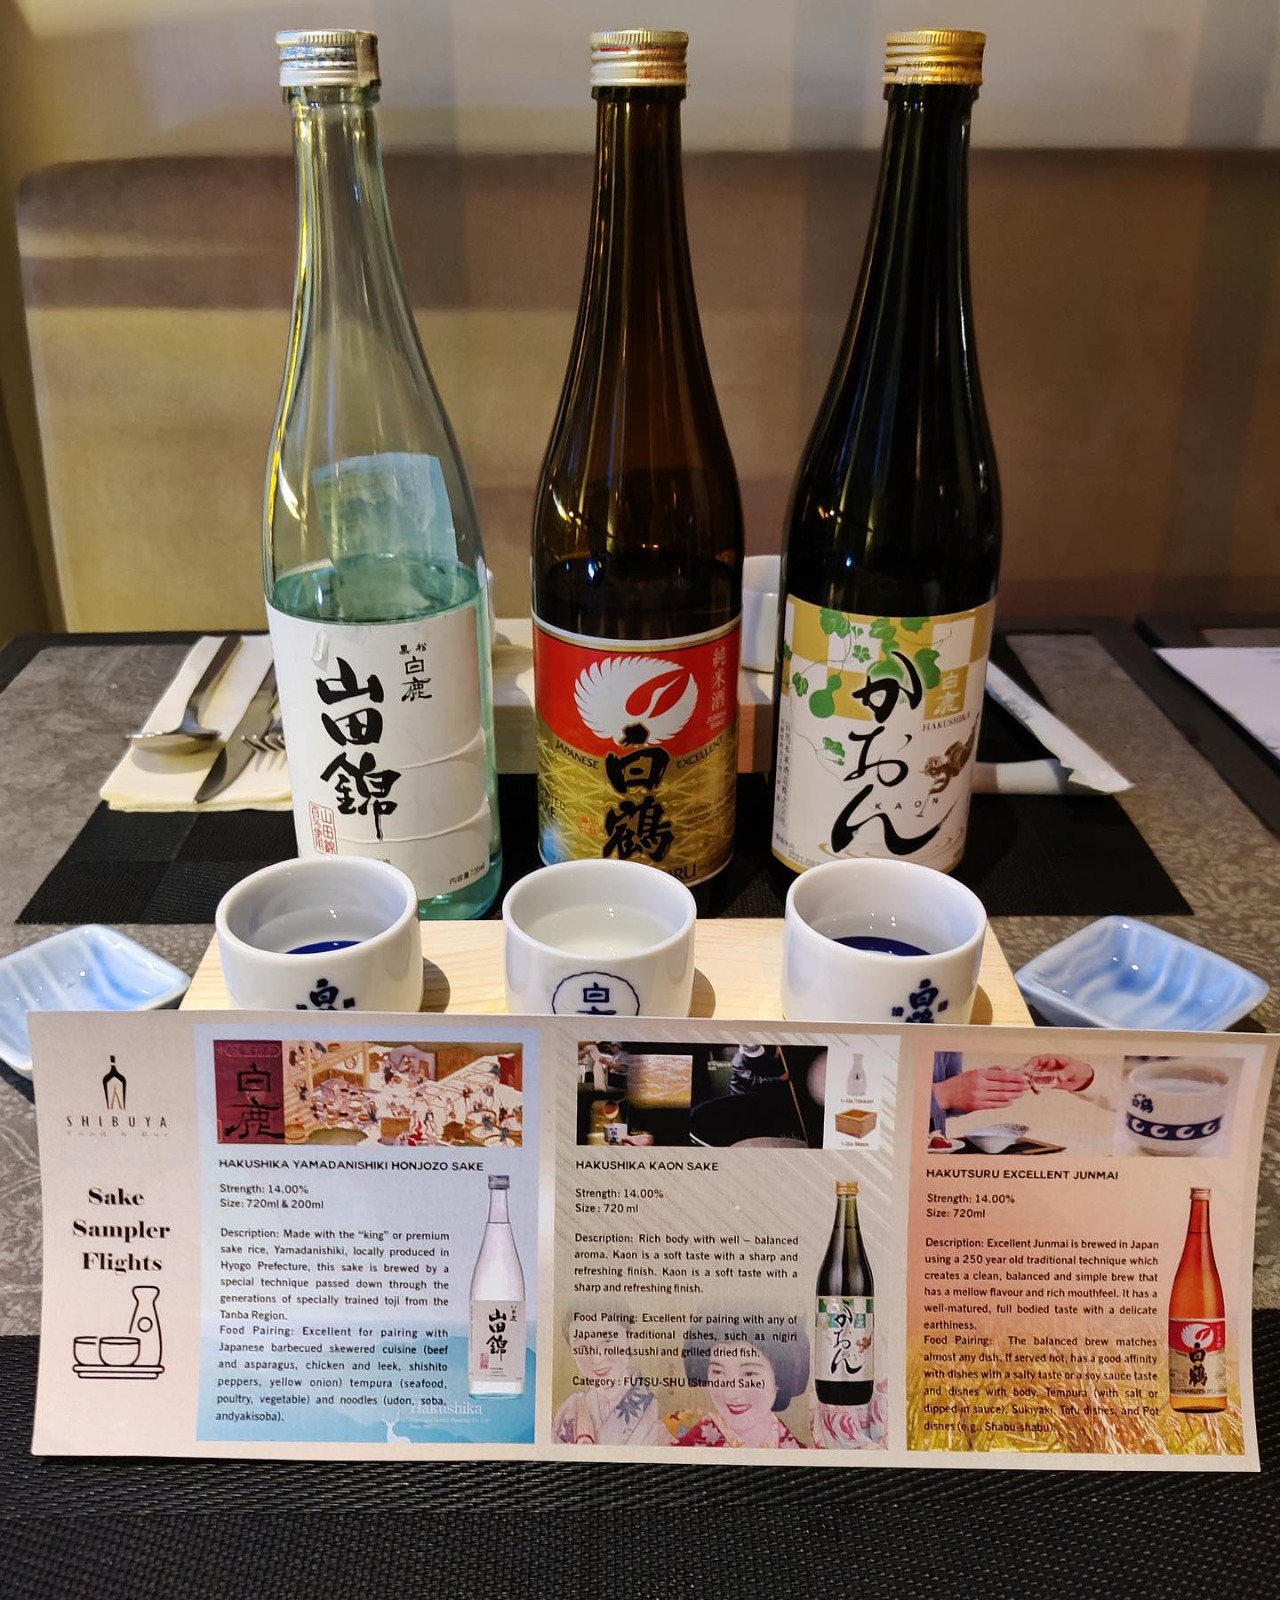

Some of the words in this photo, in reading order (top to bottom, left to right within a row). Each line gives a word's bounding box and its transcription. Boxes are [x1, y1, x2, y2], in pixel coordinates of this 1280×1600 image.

[402, 656, 432, 702] 白鹿
[316, 657, 402, 840] 山田錦
[555, 741, 599, 769] JAPANESE
[676, 737, 725, 769] EXCELLENT
[831, 651, 956, 855] かおん
[874, 796, 939, 811] KAON
[224, 1061, 285, 1140] 白鹿
[66, 1115, 167, 1128] SHIBUYA
[219, 1159, 289, 1169] HAKUSHIKA
[293, 1160, 388, 1170] YAMADANISHIKI
[391, 1161, 448, 1170] HONJOZO
[451, 1162, 483, 1171] SAKE
[576, 1160, 646, 1170] HAKUSHIKA
[649, 1161, 683, 1170] KAON
[686, 1161, 718, 1171] SAKE
[926, 1169, 999, 1178] HAKUTSURU
[1003, 1169, 1070, 1179] EXCELLENT
[1072, 1170, 1118, 1180] JUNMAI
[219, 1183, 265, 1195] Strength:
[268, 1184, 308, 1194] 14.00%
[575, 1188, 620, 1200] Strength:
[624, 1188, 664, 1198] 14.00%
[88, 1186, 144, 1206] Sake
[927, 1193, 971, 1205] Strength:
[976, 1194, 1015, 1203] 14.00%
[220, 1198, 243, 1207] Size:
[246, 1198, 279, 1208] 720ml
[291, 1199, 324, 1209] 200ml
[603, 1203, 624, 1213] 720
[626, 1204, 638, 1213] ml
[926, 1208, 949, 1218] Size:
[953, 1208, 985, 1218] 720ml
[72, 1219, 170, 1243] Sampler
[220, 1227, 279, 1239] Description:
[283, 1228, 310, 1238] Made
[314, 1230, 335, 1239] with
[338, 1230, 354, 1239] the
[405, 1231, 449, 1242] premium
[574, 1232, 633, 1244] Description:
[638, 1233, 660, 1243] Rich
[665, 1234, 689, 1245] body
[693, 1234, 715, 1244] with
[720, 1234, 739, 1244] well
[754, 1235, 798, 1245] balanced
[925, 1237, 984, 1249] Description:
[987, 1238, 1030, 1248] Excellent
[1033, 1239, 1068, 1248] Junmai
[1081, 1239, 1116, 1249] brewed
[1130, 1240, 1159, 1251] Japan
[220, 1244, 242, 1253] sake
[247, 1244, 269, 1255] rice,
[274, 1245, 347, 1256] Yamadanishiki,
[353, 1246, 384, 1258] locally
[389, 1247, 435, 1258] produced
[574, 1251, 608, 1259] aroma.
[612, 1249, 637, 1259] Kaon
[664, 1250, 681, 1260] soft
[685, 1251, 710, 1260] taste
[714, 1251, 735, 1261] with
[749, 1252, 776, 1263] sharp
[780, 1252, 798, 1261] and
[81, 1251, 163, 1275] Flights
[220, 1260, 251, 1272] Hyogo
[257, 1260, 310, 1272] Prefecture,
[317, 1262, 335, 1271] this
[341, 1262, 363, 1272] sake
[383, 1263, 419, 1272] brewed
[924, 1254, 951, 1265] using
[962, 1254, 983, 1264] 250
[985, 1257, 1006, 1266] year
[1008, 1255, 1024, 1264] old
[1026, 1255, 1076, 1264] traditional
[1078, 1255, 1126, 1267] technique
[1129, 1256, 1158, 1265] which
[574, 1266, 622, 1277] refreshing
[627, 1266, 656, 1276] finish.
[662, 1267, 686, 1276] Kaon
[715, 1267, 733, 1277] soft
[738, 1268, 761, 1277] taste
[766, 1268, 787, 1278] with
[924, 1271, 960, 1280] creates
[972, 1271, 1002, 1281] clean,
[1006, 1271, 1050, 1280] balanced
[1053, 1271, 1072, 1281] and
[1076, 1272, 1107, 1283] simple
[1111, 1272, 1134, 1282] brew
[1138, 1272, 1158, 1282] that
[220, 1276, 254, 1288] special
[260, 1277, 309, 1289] technique
[315, 1278, 349, 1290] passed
[355, 1279, 382, 1288] down
[389, 1279, 427, 1291] through
[433, 1280, 449, 1290] the
[924, 1286, 941, 1296] has
[952, 1287, 987, 1296] mellow
[990, 1287, 1023, 1297] flavour
[1025, 1288, 1044, 1297] and
[1046, 1288, 1065, 1297] rich
[1067, 1288, 1119, 1298] mouthfeel.
[1132, 1288, 1149, 1298] has
[220, 1293, 276, 1305] generations
[296, 1294, 339, 1306] specially
[344, 1295, 379, 1305] trained
[384, 1295, 399, 1307] toji
[405, 1296, 428, 1306] from
[433, 1297, 448, 1306] the
[219, 1309, 249, 1319] Tanba
[251, 1310, 287, 1322] Region.
[574, 1312, 597, 1322] Food
[600, 1312, 637, 1324] Pairing:
[642, 1313, 686, 1323] Excellent
[689, 1313, 702, 1323] for
[706, 1314, 739, 1325] pairing
[742, 1314, 764, 1324] with
[767, 1316, 784, 1326] any
[219, 1324, 244, 1335] Food
[252, 1325, 294, 1337] Pairing:
[302, 1326, 351, 1336] Excellent
[358, 1327, 373, 1337] for
[380, 1328, 417, 1339] pairing
[425, 1328, 448, 1338] with
[218, 1342, 264, 1354] Japanese
[271, 1342, 322, 1353] barbecued
[329, 1343, 375, 1354] skewered
[382, 1344, 416, 1354] cuisine
[423, 1344, 448, 1355] (beef
[218, 1359, 237, 1368] and
[244, 1361, 298, 1371] asparagus,
[305, 1360, 344, 1370] chicken
[351, 1360, 370, 1370] and
[378, 1361, 401, 1371] leek,
[409, 1361, 448, 1372] shishito
